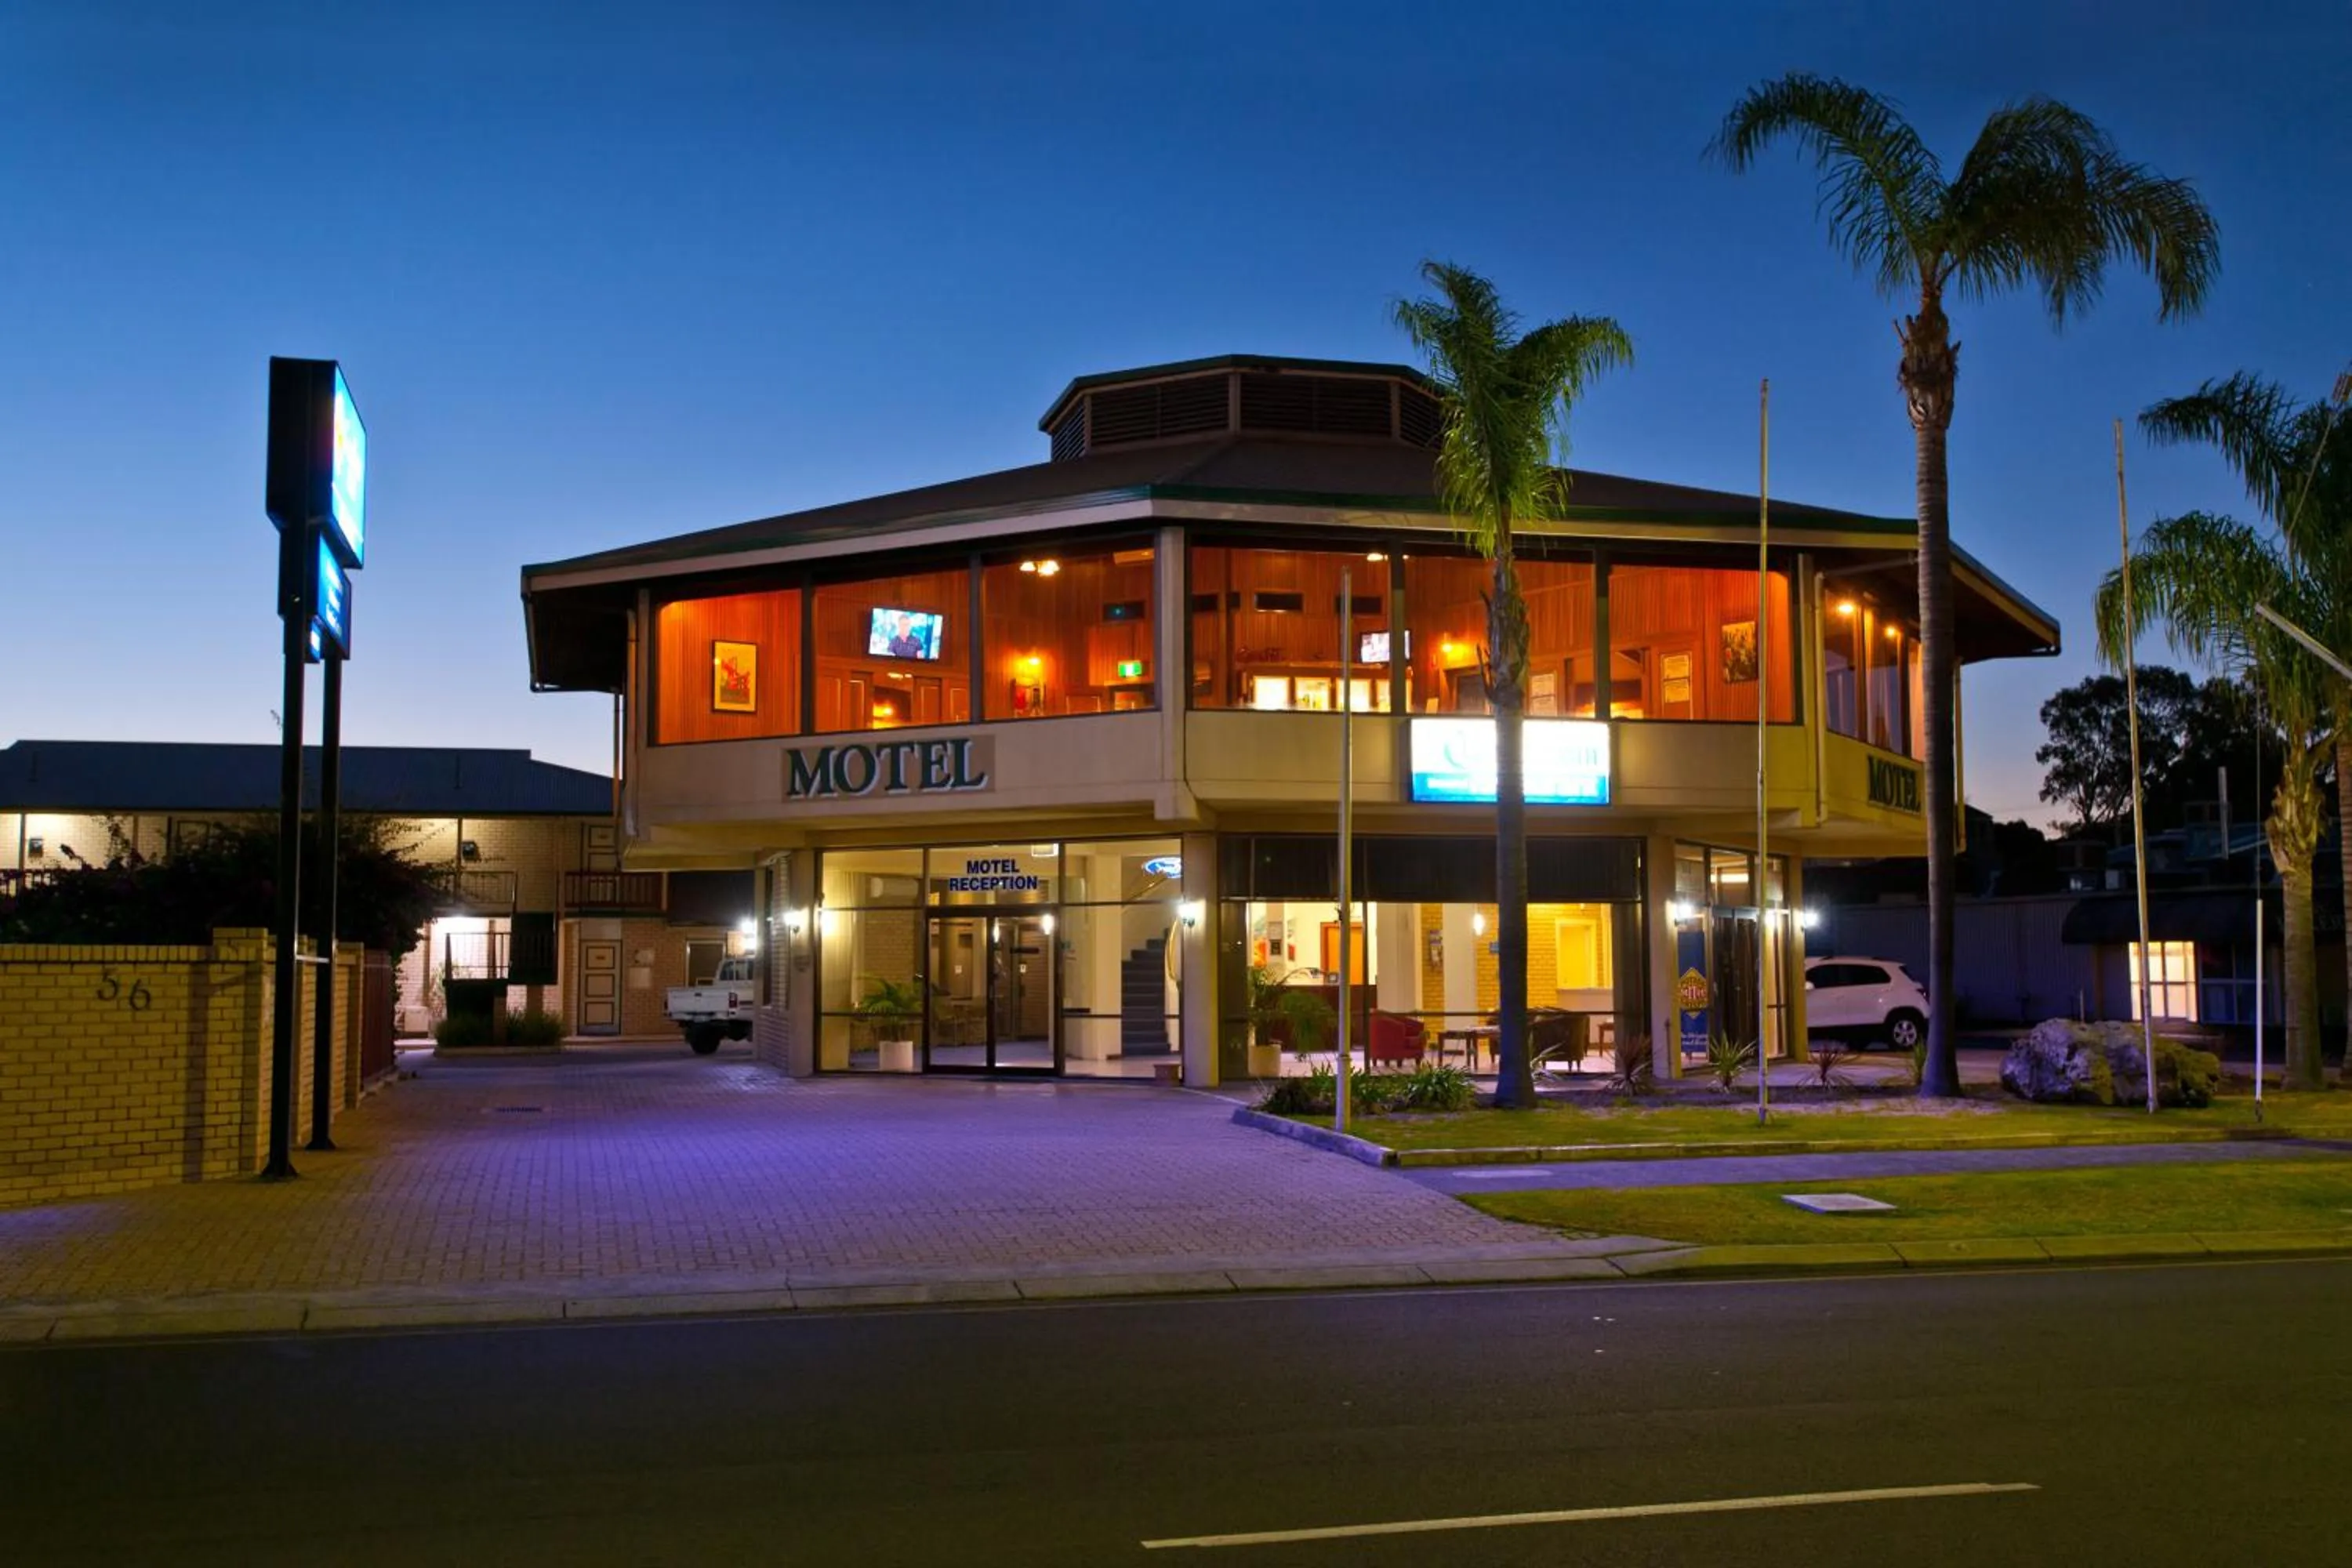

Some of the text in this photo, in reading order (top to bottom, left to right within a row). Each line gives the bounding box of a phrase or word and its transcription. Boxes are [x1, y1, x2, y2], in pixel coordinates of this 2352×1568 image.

[786, 739, 988, 799] MOTEL
[1867, 754, 1921, 813] MOTEL
[949, 876, 1037, 891] RECEPTION
[967, 859, 1019, 873] MOTEL
[96, 967, 151, 1011] 56
